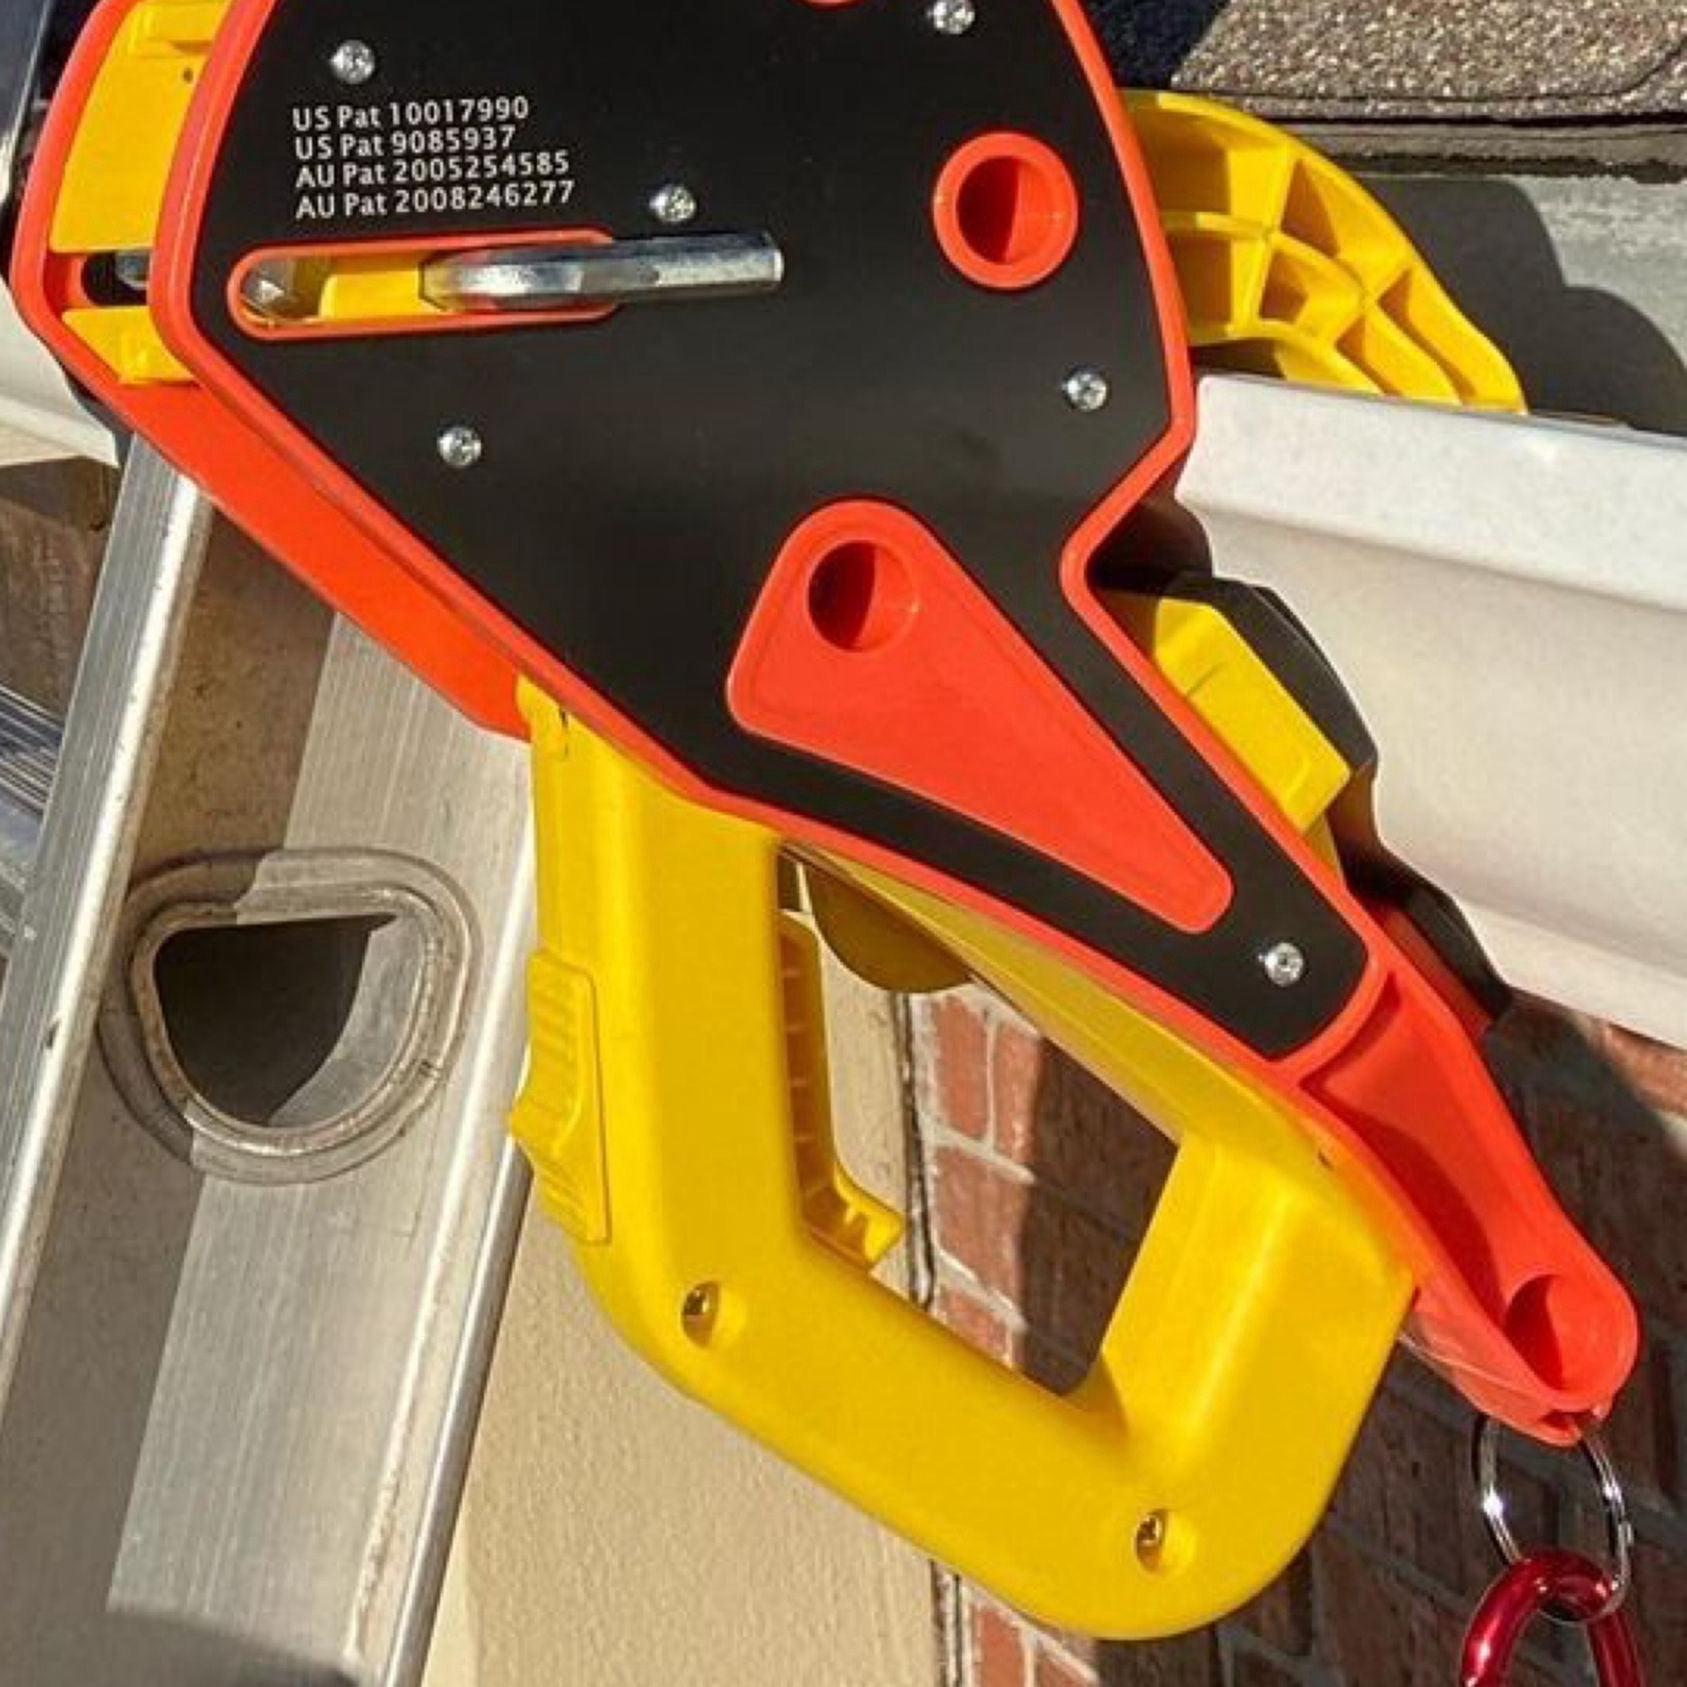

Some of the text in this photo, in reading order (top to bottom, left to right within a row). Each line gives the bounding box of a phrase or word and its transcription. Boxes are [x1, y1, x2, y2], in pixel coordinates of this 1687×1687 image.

[292, 95, 529, 131] US Pat 10017990
[295, 124, 516, 160] US Pat 9085937
[295, 149, 569, 189] AU Pat 2005254585
[295, 179, 575, 219] AU Pat 2008246277
